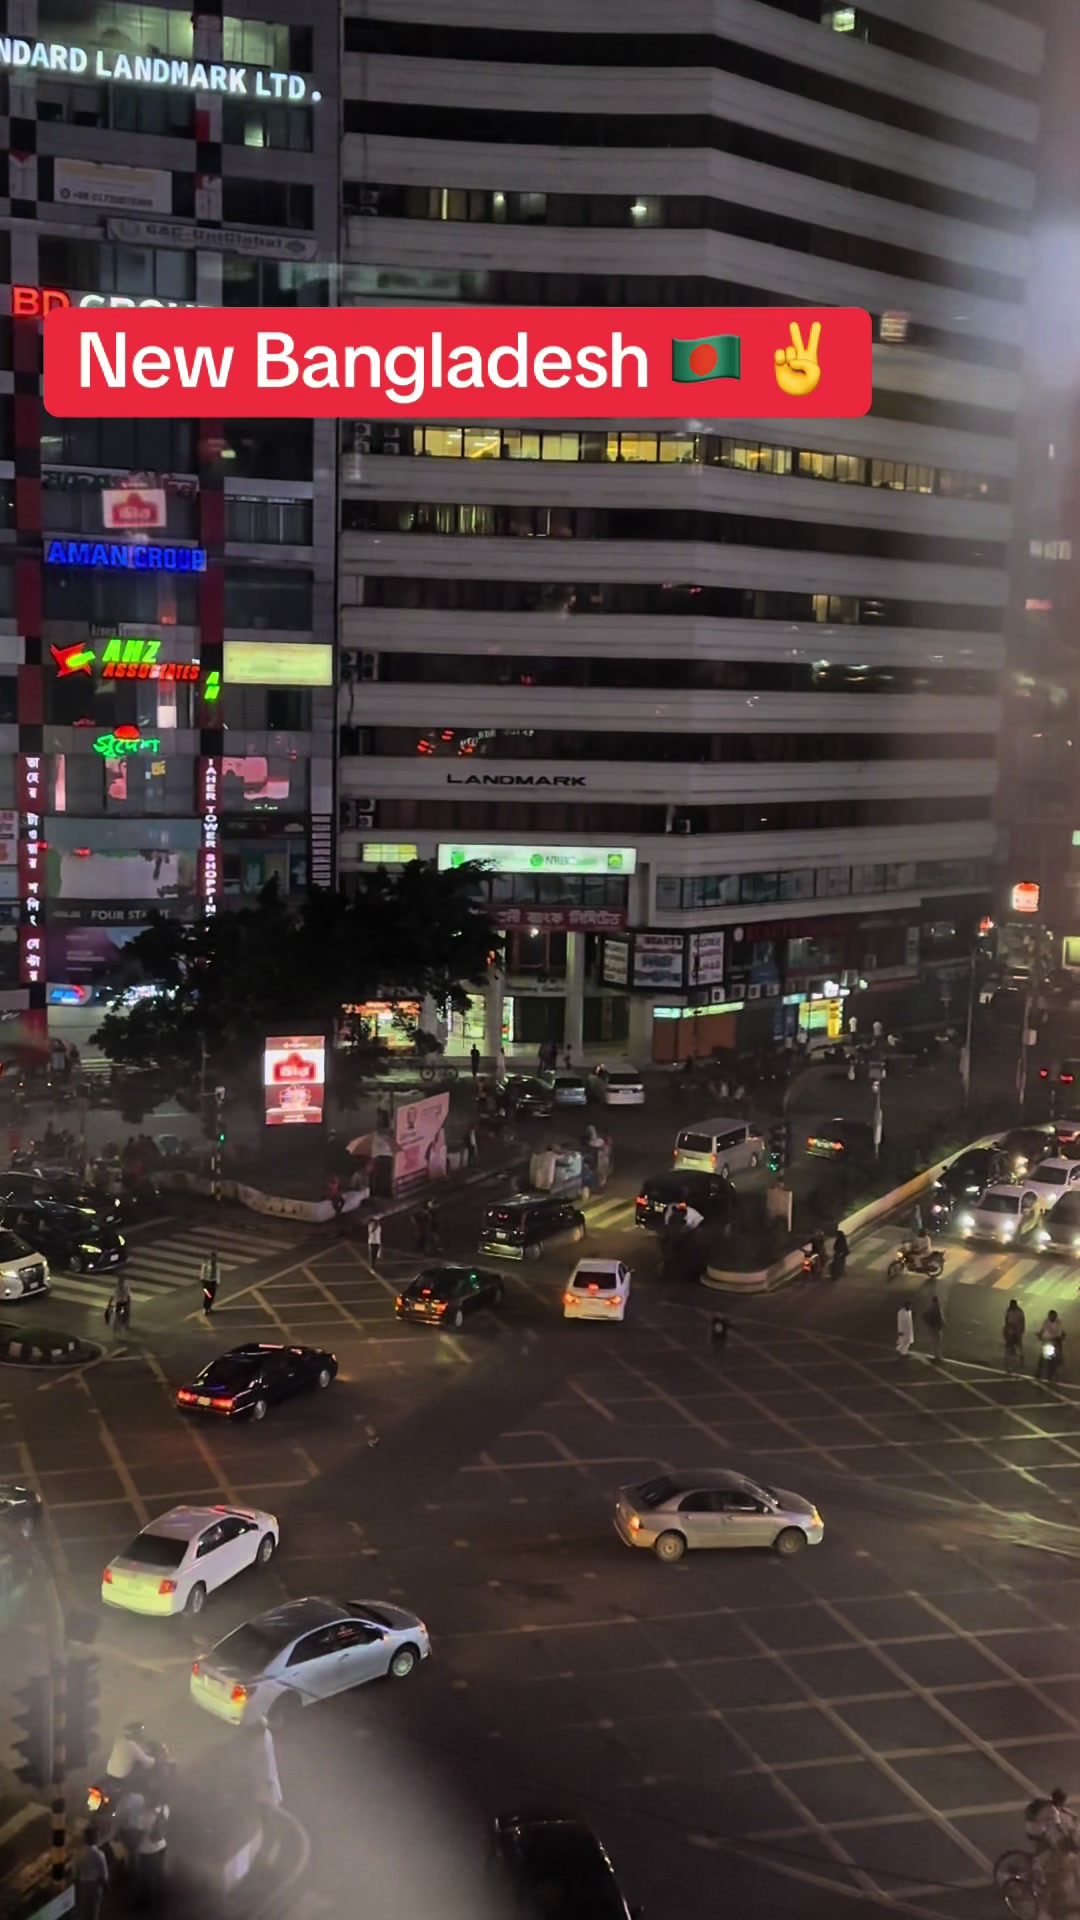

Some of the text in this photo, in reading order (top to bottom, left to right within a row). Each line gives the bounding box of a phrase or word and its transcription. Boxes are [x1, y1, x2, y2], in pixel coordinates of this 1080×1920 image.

[95, 50, 248, 94] LANDMARK
[12, 286, 70, 317] BD
[47, 541, 206, 571] AMAN GROUP
[102, 662, 200, 680] ASSOCIATES
[446, 773, 587, 787] LANDMARK
[203, 805, 218, 848] TOWER
[205, 853, 217, 918] SHOPPIN
[91, 909, 125, 920] FOUR
